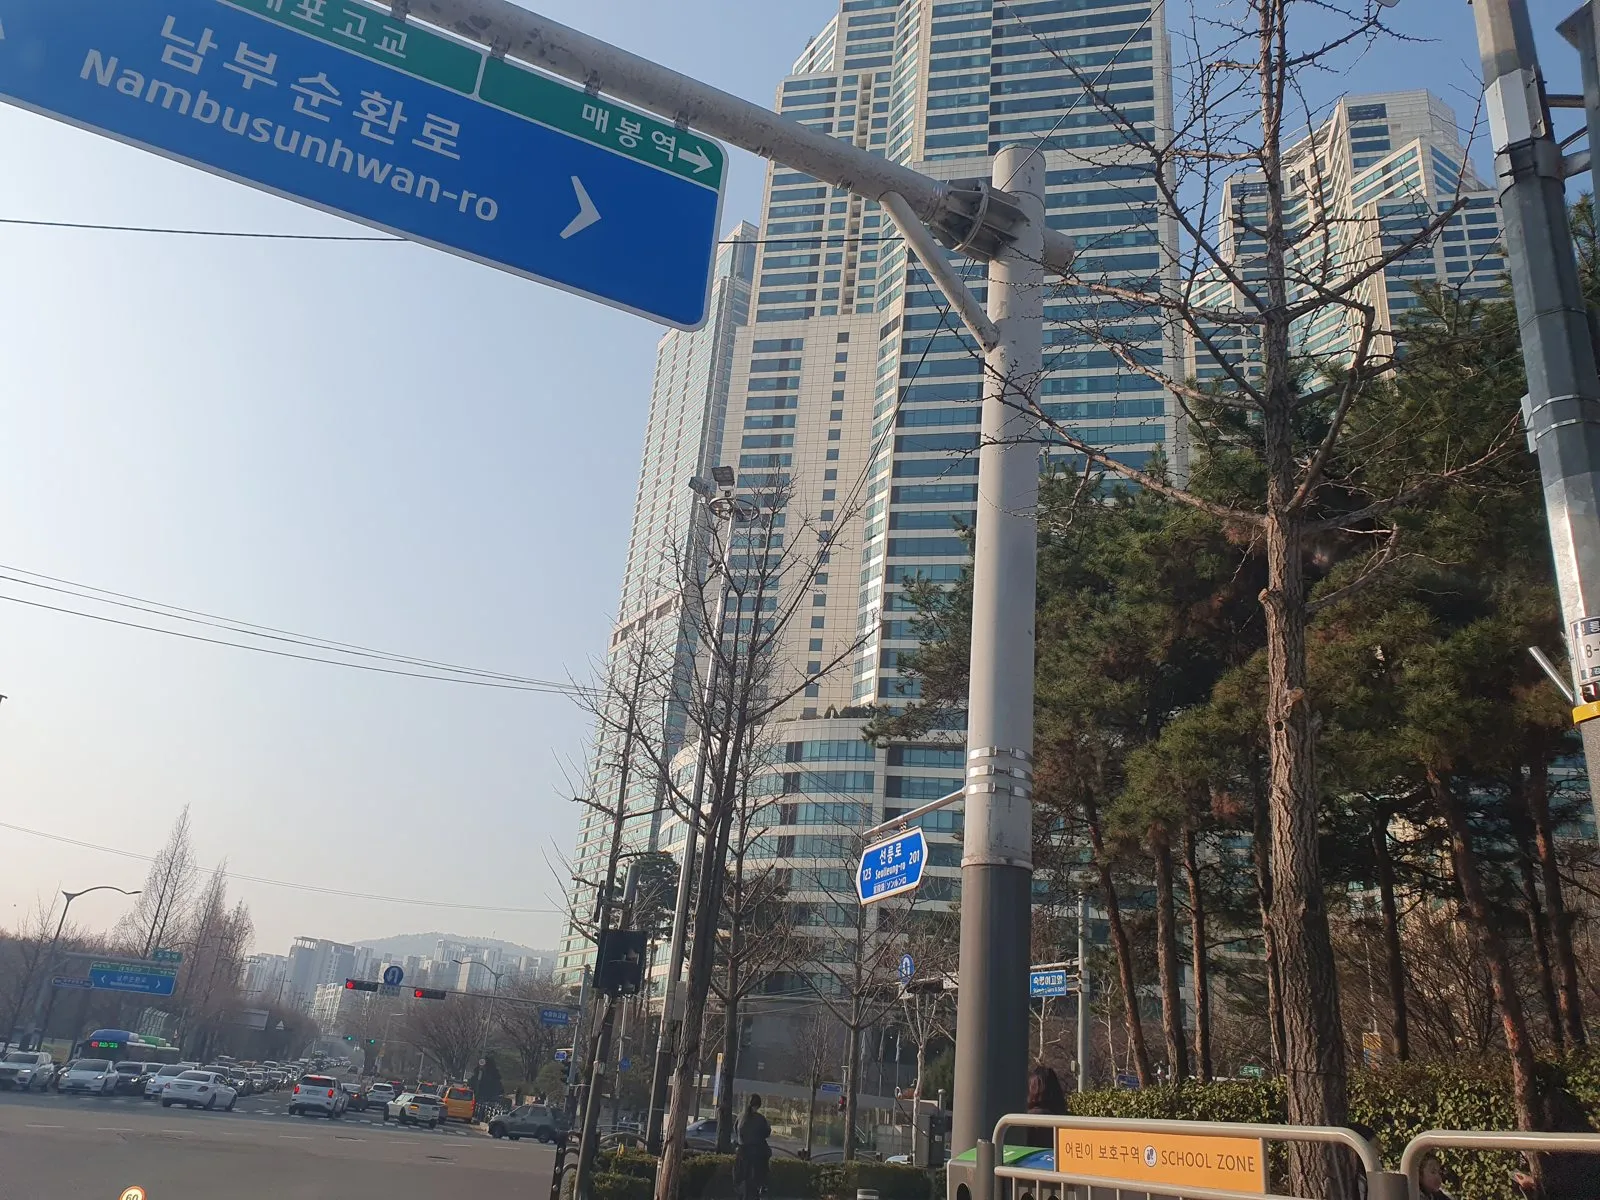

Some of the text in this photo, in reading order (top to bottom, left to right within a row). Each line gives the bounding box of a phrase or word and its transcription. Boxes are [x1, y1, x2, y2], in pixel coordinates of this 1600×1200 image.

[160, 15, 461, 161] 남부순환로
[79, 48, 499, 222] Nambusunhwan-ro
[581, 103, 677, 163] 매봉역
[879, 842, 902, 866] 선릉로
[908, 849, 920, 865] 201
[862, 867, 872, 881] 123
[1065, 1141, 1140, 1165] 어린이 보호구역
[1161, 1150, 1255, 1172] SCHOOL ZONE
